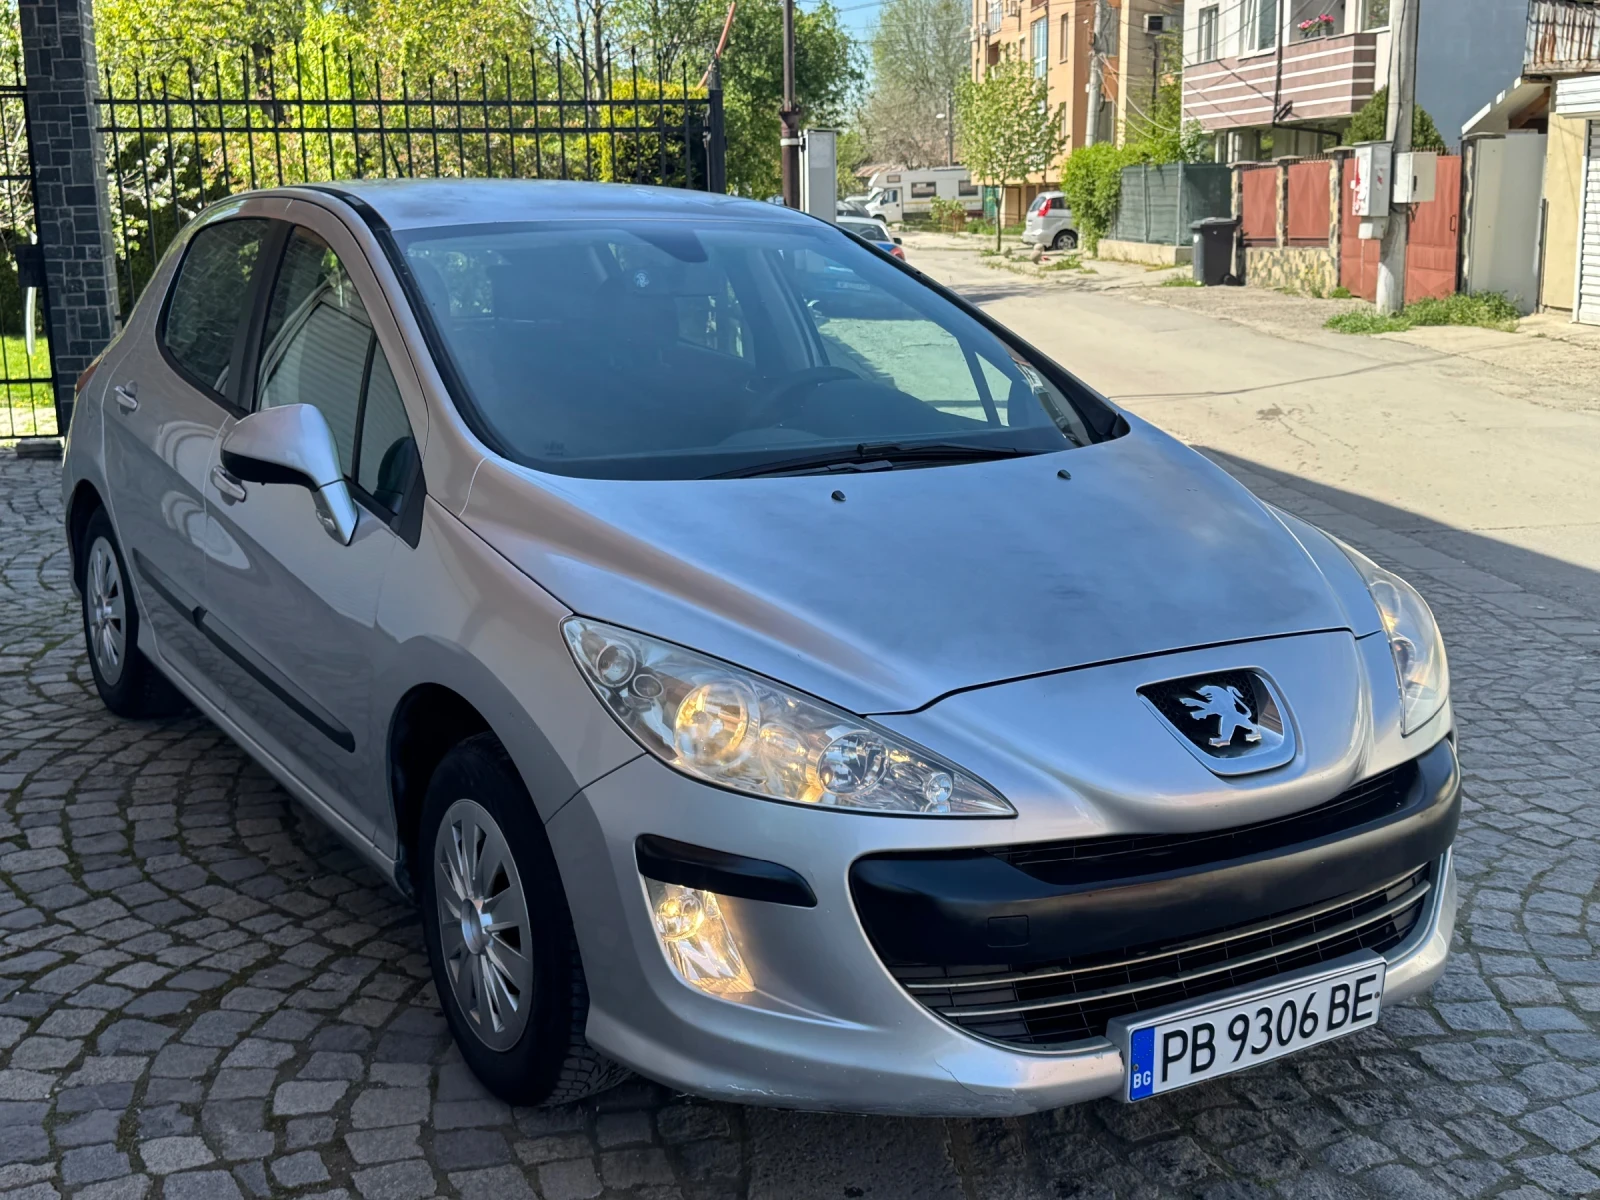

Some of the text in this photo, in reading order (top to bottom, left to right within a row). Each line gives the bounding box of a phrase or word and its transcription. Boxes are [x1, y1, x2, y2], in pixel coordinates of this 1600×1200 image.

[1161, 974, 1377, 1082] PB 9306 BE
[1133, 1070, 1151, 1089] BG
